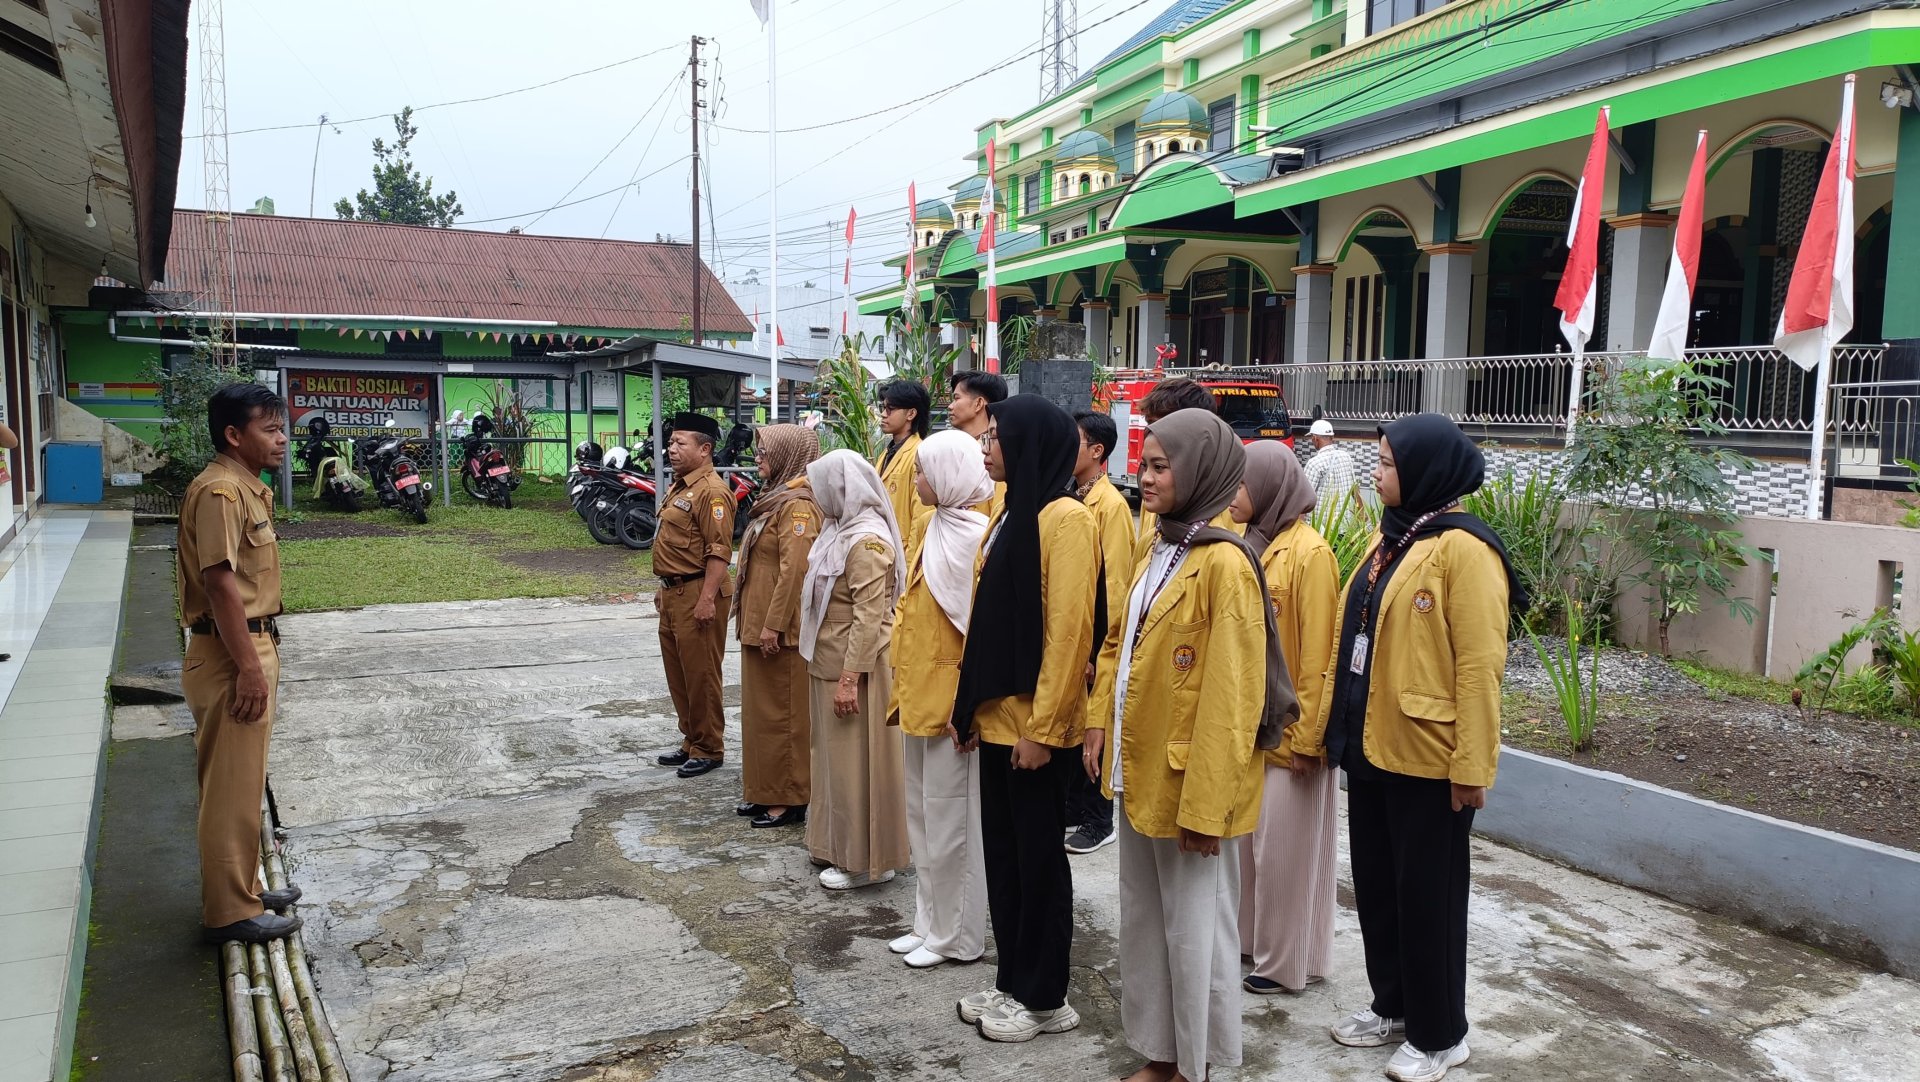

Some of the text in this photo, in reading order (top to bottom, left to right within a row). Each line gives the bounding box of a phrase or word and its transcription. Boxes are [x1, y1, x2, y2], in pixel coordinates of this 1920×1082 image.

[306, 376, 409, 395] BAKTI SOSIAL
[1212, 388, 1278, 397] ATRIA BIRU
[294, 395, 420, 411] BANTUAN AIR
[324, 411, 393, 426] BERSIH
[330, 427, 369, 437] POLRES
[1411, 515, 1428, 531] BELIK
[1184, 524, 1199, 543] BELIK
